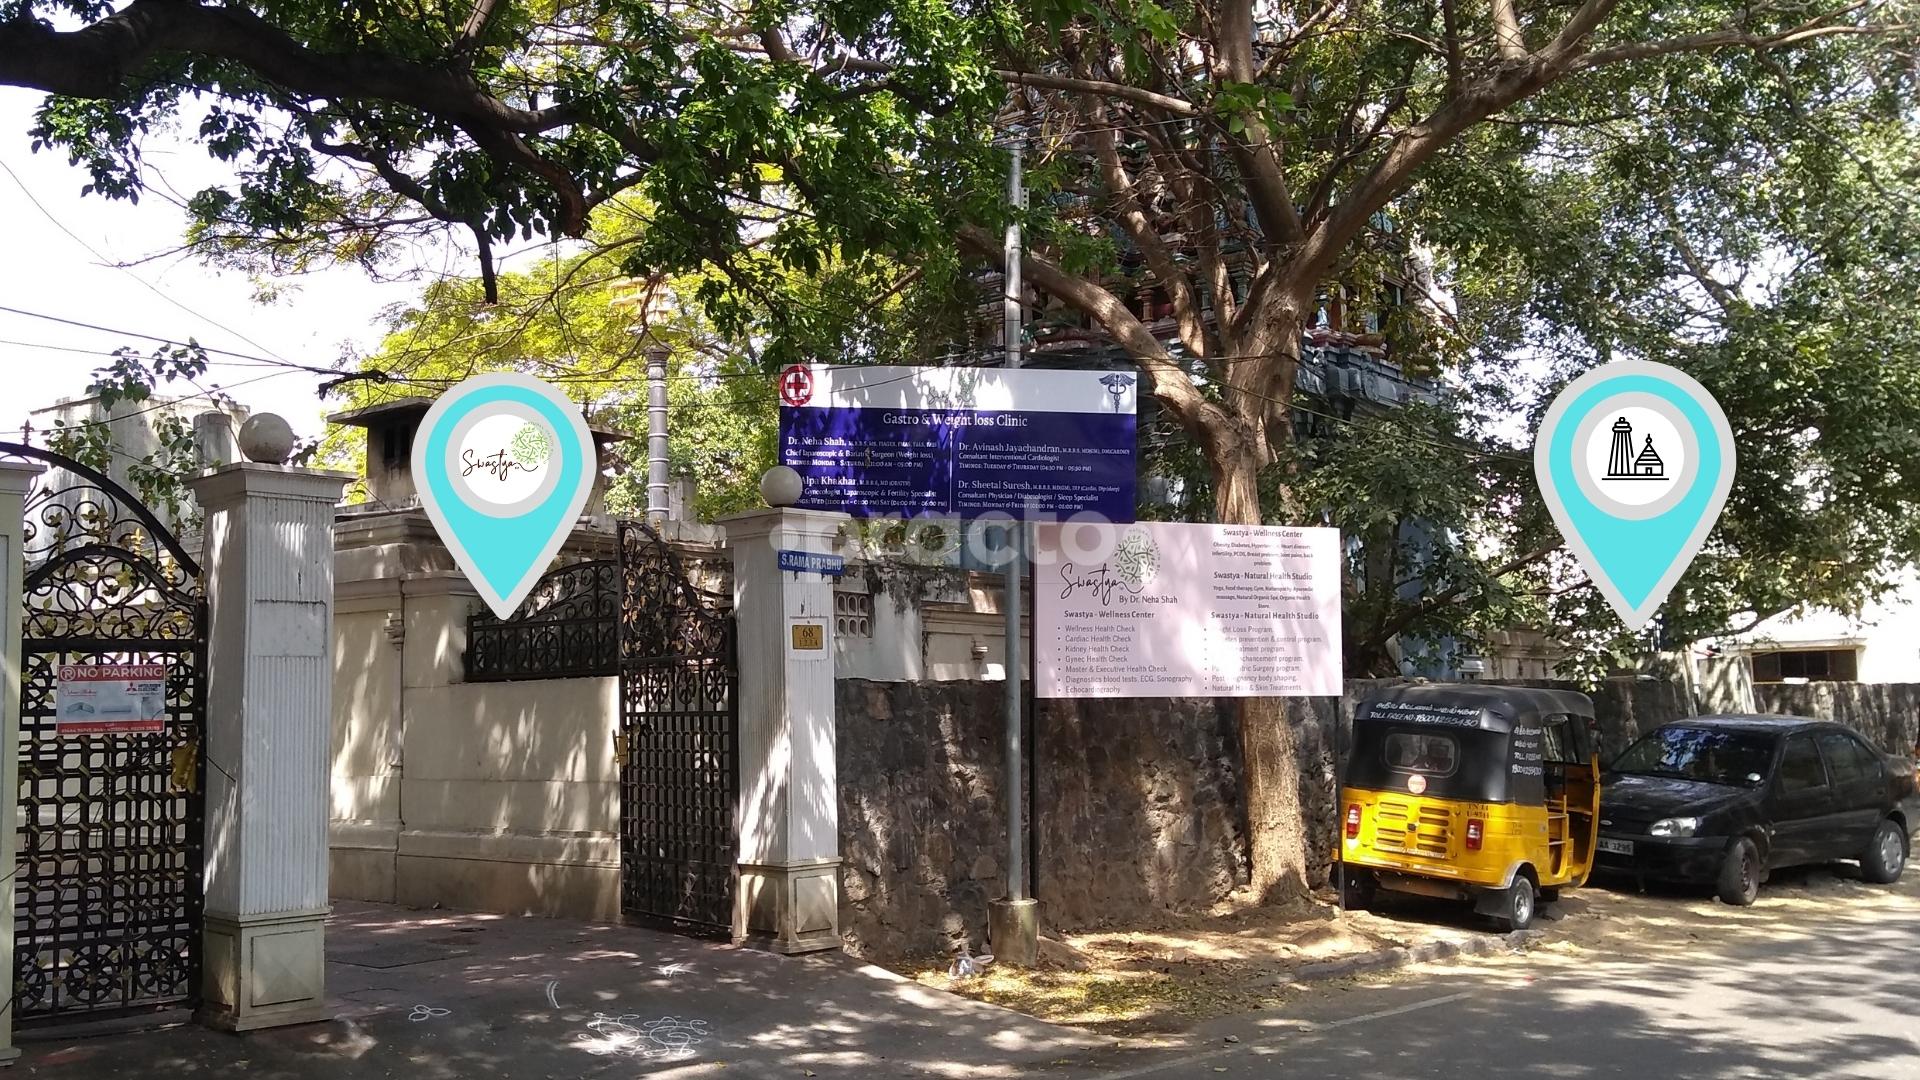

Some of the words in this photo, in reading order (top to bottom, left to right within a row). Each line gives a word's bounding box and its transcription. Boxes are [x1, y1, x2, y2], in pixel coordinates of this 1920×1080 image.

[883, 413, 919, 425] Gastro
[921, 414, 930, 425] &
[932, 413, 972, 428] Weight
[974, 414, 994, 426] loss
[996, 414, 1028, 427] Clinic
[788, 436, 800, 446] Dr.
[801, 437, 823, 446] Neha
[958, 442, 971, 451] Dr.
[973, 442, 1004, 452] Avinash
[785, 449, 801, 457] Chief
[871, 450, 895, 460] Surgeon
[989, 453, 1027, 461] Interventional
[1028, 454, 1060, 462] Cardiologist
[958, 480, 971, 489] Dr.
[972, 480, 1001, 490] Sheetal
[887, 490, 909, 499] Fertility
[911, 490, 936, 499] Specialist
[988, 492, 1013, 500] Physician
[1058, 493, 1073, 501] Sleep
[1074, 493, 1099, 501] Specialist
[1223, 528, 1249, 538] Swastya
[1282, 530, 1303, 538] Center
[781, 553, 810, 569] S.RAMA
[811, 557, 842, 571] PRABHU
[1213, 571, 1240, 580] Swastya
[1244, 571, 1268, 580] Natural
[1292, 572, 1313, 580] Studio
[1060, 563, 1145, 606] Swastya
[1119, 595, 1128, 604] By
[1141, 595, 1159, 604] Neha
[1161, 596, 1178, 604] Shah
[1064, 610, 1093, 619] Swastya
[1211, 611, 1240, 620] Swastya
[1272, 612, 1295, 620] Health
[1296, 612, 1319, 620] Studio
[802, 627, 814, 638] 68
[1065, 645, 1086, 653] Kidney
[77, 667, 98, 678] NO
[102, 667, 163, 678] PARKING
[1253, 665, 1275, 674] Surgery
[1066, 676, 1102, 684] Diagnostics
[1156, 675, 1192, 684] Sonography
[1258, 675, 1273, 683] body
[1212, 684, 1234, 692] Natural
[1255, 684, 1269, 692] Skin
[1370, 711, 1386, 719] TOLL
[1387, 712, 1405, 720] FREE
